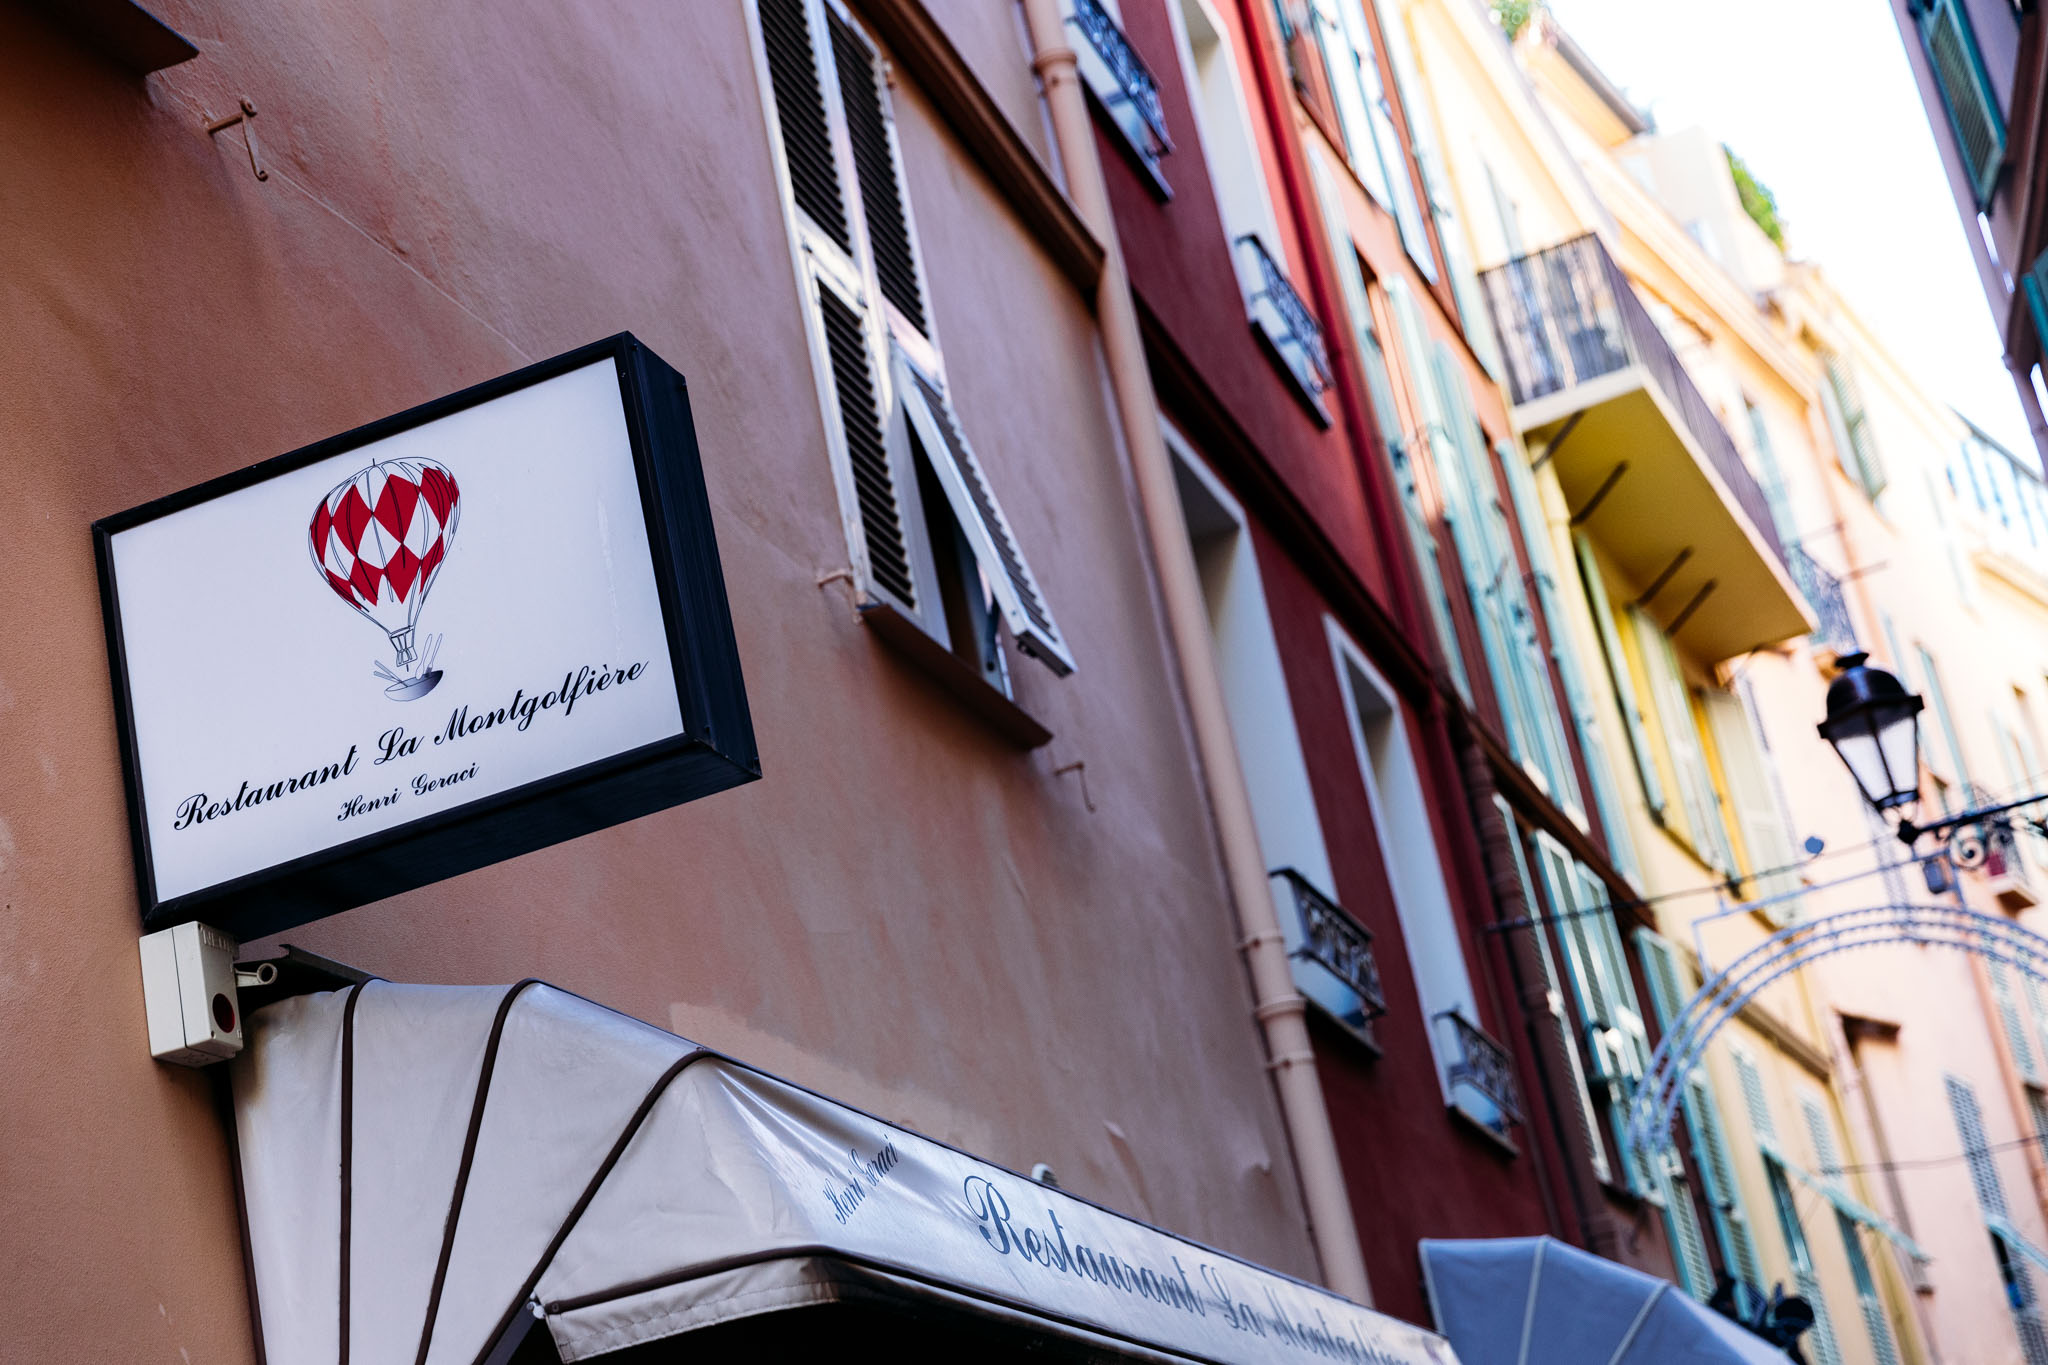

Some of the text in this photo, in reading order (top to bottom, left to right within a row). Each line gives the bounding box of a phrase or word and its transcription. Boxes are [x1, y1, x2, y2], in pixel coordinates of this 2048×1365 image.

[173, 660, 649, 831] Restaurant La Montgolfière
[337, 762, 480, 822] Henri Geraci
[822, 1132, 899, 1225] Henri Geraci
[963, 1174, 1206, 1318] Restaurant
[1200, 1263, 1266, 1338] La
